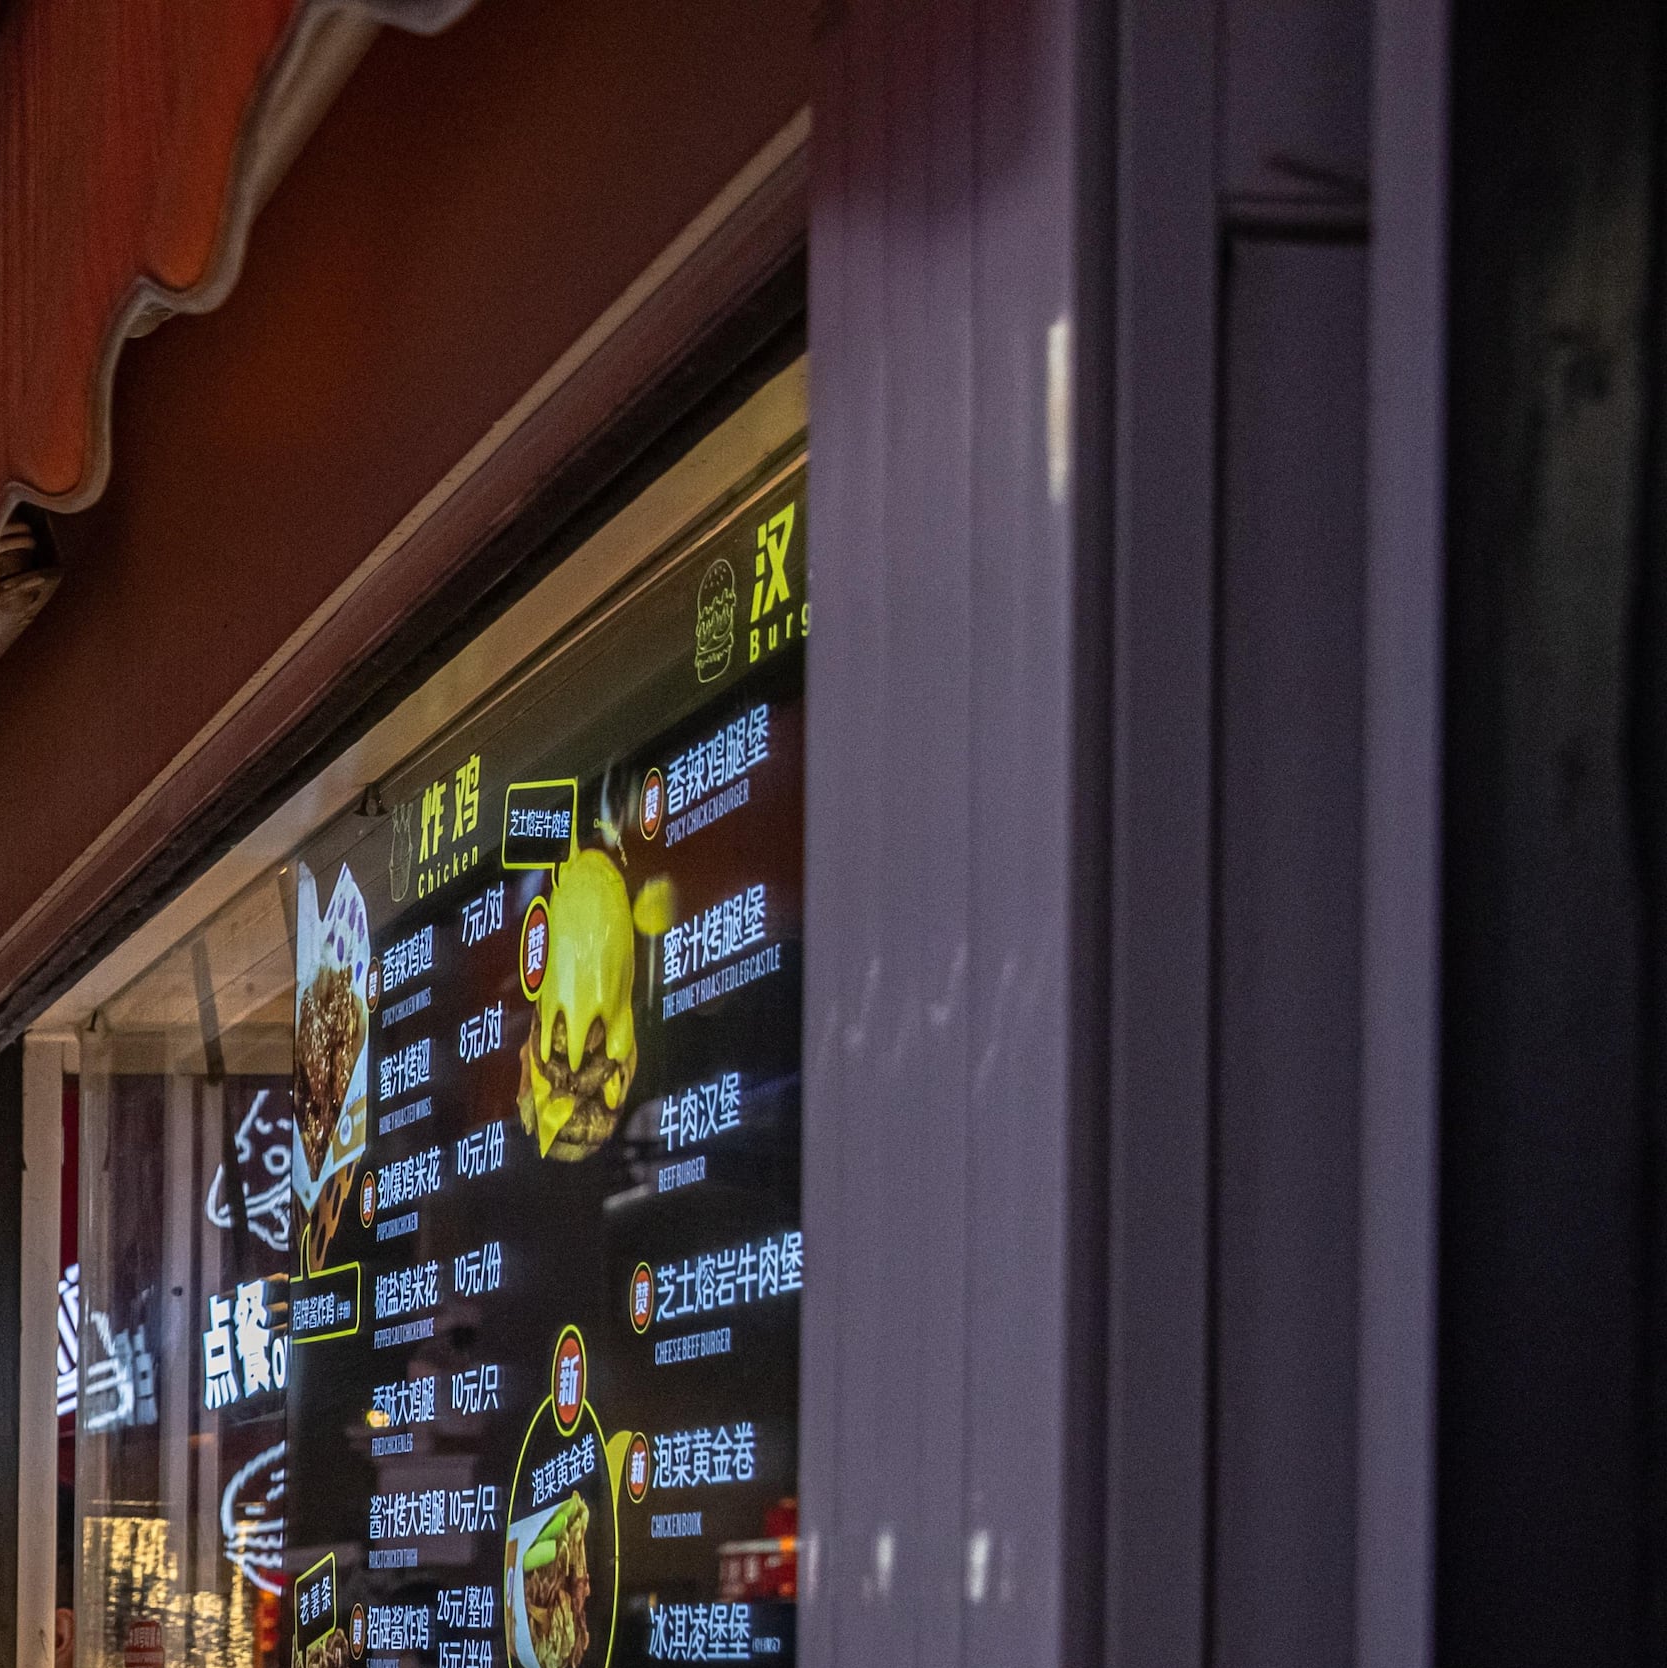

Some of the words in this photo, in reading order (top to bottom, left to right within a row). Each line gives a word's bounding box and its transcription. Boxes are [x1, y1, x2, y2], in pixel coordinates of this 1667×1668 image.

[750, 501, 795, 623] 汉
[644, 785, 660, 824] 赞
[666, 703, 768, 815] 香辣鸡腿堡
[418, 753, 481, 863] 炸鸡
[665, 814, 686, 848] SPICY
[418, 845, 479, 899] Chicken
[382, 924, 434, 993] 香辣鸡翅
[461, 880, 504, 948] 7元/对
[526, 923, 546, 976] 赞
[663, 884, 766, 985] 蜜汁烤腿堡
[699, 963, 734, 1004] ROASTED
[749, 942, 780, 981] CASTLE
[379, 1037, 431, 1101] 蜜汁烤翅
[459, 1000, 502, 1063] 8元/对
[660, 1072, 741, 1151] 牛肉汉堡
[377, 1145, 441, 1210] 劲爆鸡米花
[457, 1120, 505, 1180] 10元/份
[658, 1164, 676, 1194] BEEF
[675, 1154, 705, 1188] BURGER
[454, 1241, 503, 1297] 10元/份
[635, 1281, 649, 1315] 赞
[656, 1231, 804, 1322] 芝士熔岩牛肉堡
[203, 1279, 273, 1411] 点餐
[654, 1337, 682, 1367] CHEESE
[681, 1332, 700, 1361] BEEF
[700, 1325, 731, 1356] BURGER
[451, 1364, 499, 1416] 10元/只
[558, 1354, 580, 1406] 新
[532, 1433, 595, 1507] 泡菜黄金卷
[630, 1451, 646, 1484] 新
[652, 1422, 754, 1488] 泡菜黄金卷
[369, 1490, 446, 1540] 酱汁烤大鸡腿
[449, 1485, 496, 1534] 10元/只
[650, 1513, 681, 1539] CHICKEN
[681, 1511, 701, 1536] BOOK
[300, 1576, 332, 1626] 老薯条
[367, 1605, 429, 1650] 招牌酱炸鸡
[436, 1586, 494, 1628] 26元/整份
[648, 1603, 750, 1661] 冰淇凌堡堡
